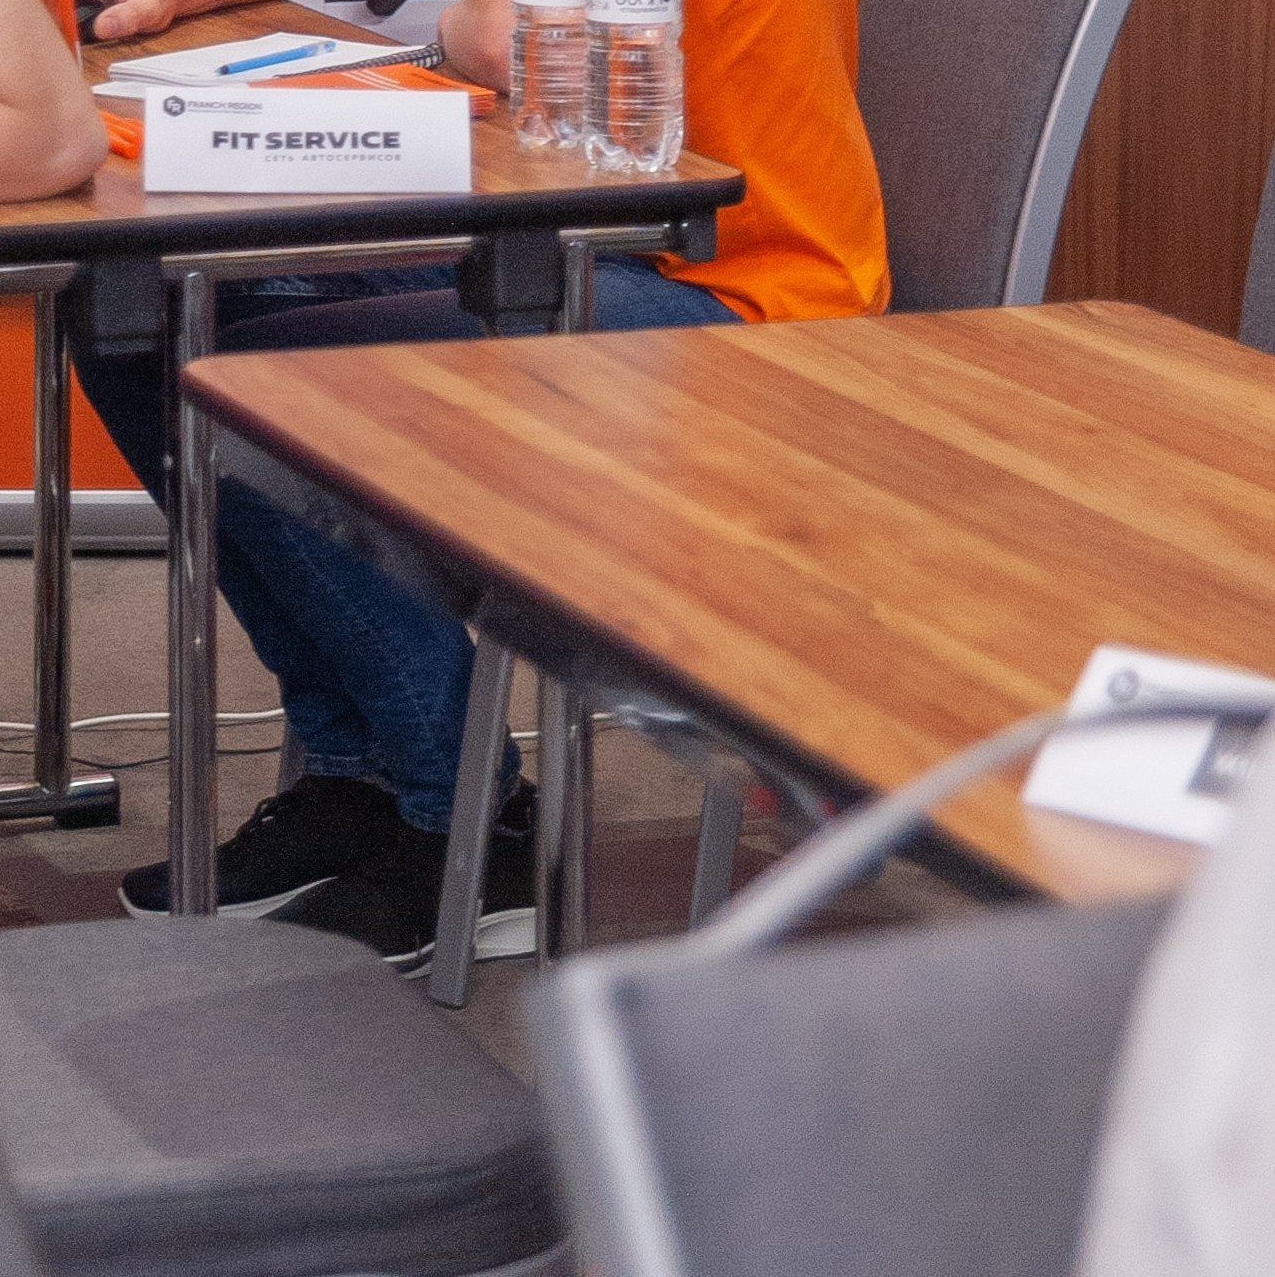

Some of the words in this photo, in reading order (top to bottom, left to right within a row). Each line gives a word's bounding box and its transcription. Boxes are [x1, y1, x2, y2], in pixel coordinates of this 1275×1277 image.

[211, 130, 261, 151] FIT
[264, 130, 402, 151] SERVICE
[301, 153, 402, 163] АВТОСЕРВИСОВ
